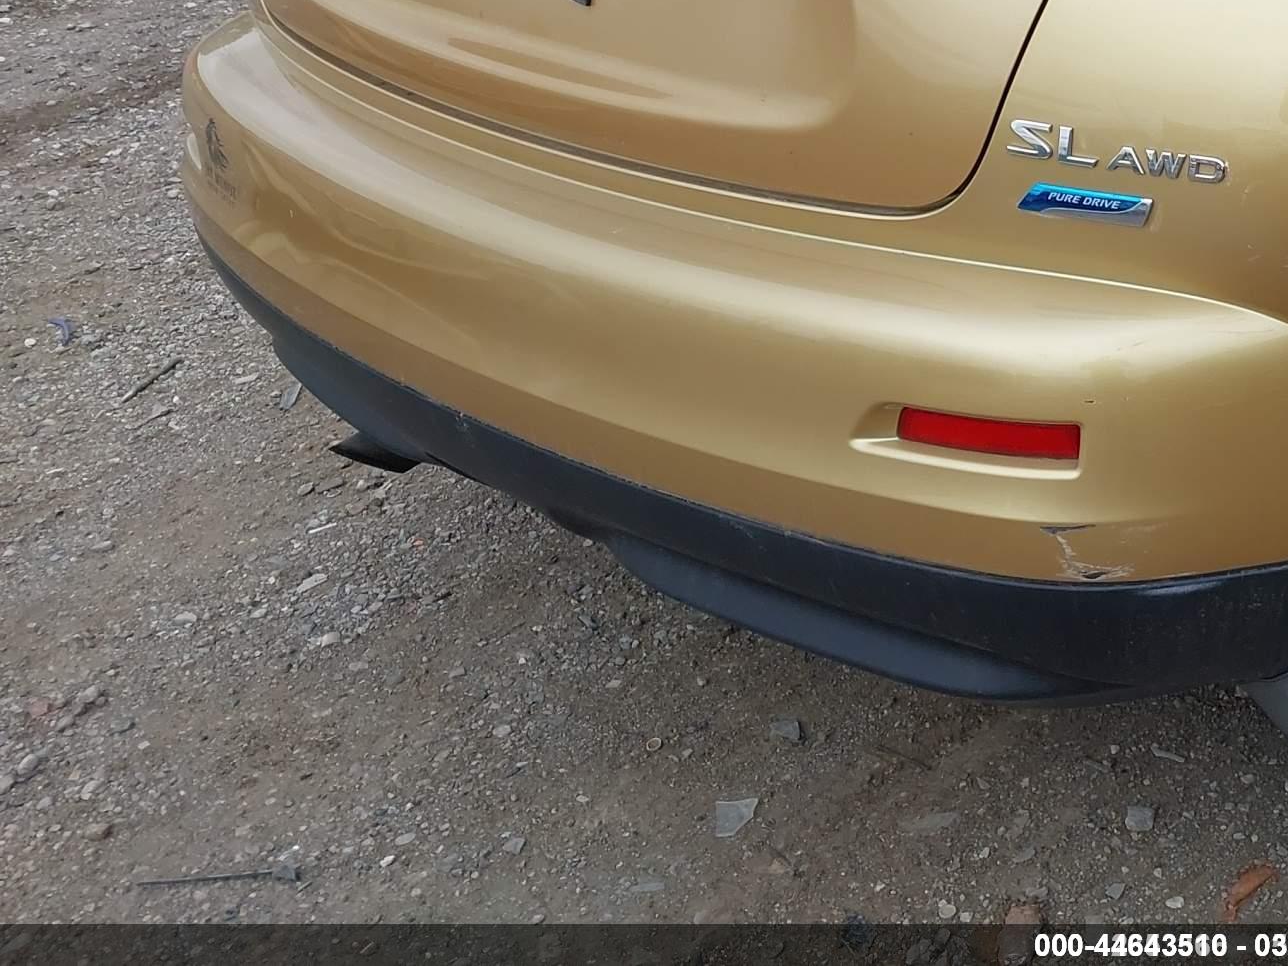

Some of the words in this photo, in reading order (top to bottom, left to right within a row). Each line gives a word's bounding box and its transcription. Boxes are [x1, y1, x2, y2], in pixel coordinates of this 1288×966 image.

[1006, 119, 1099, 168] SL
[1106, 146, 1227, 183] AWD
[1047, 191, 1081, 206] PURE
[1083, 196, 1121, 210] DRIVE
